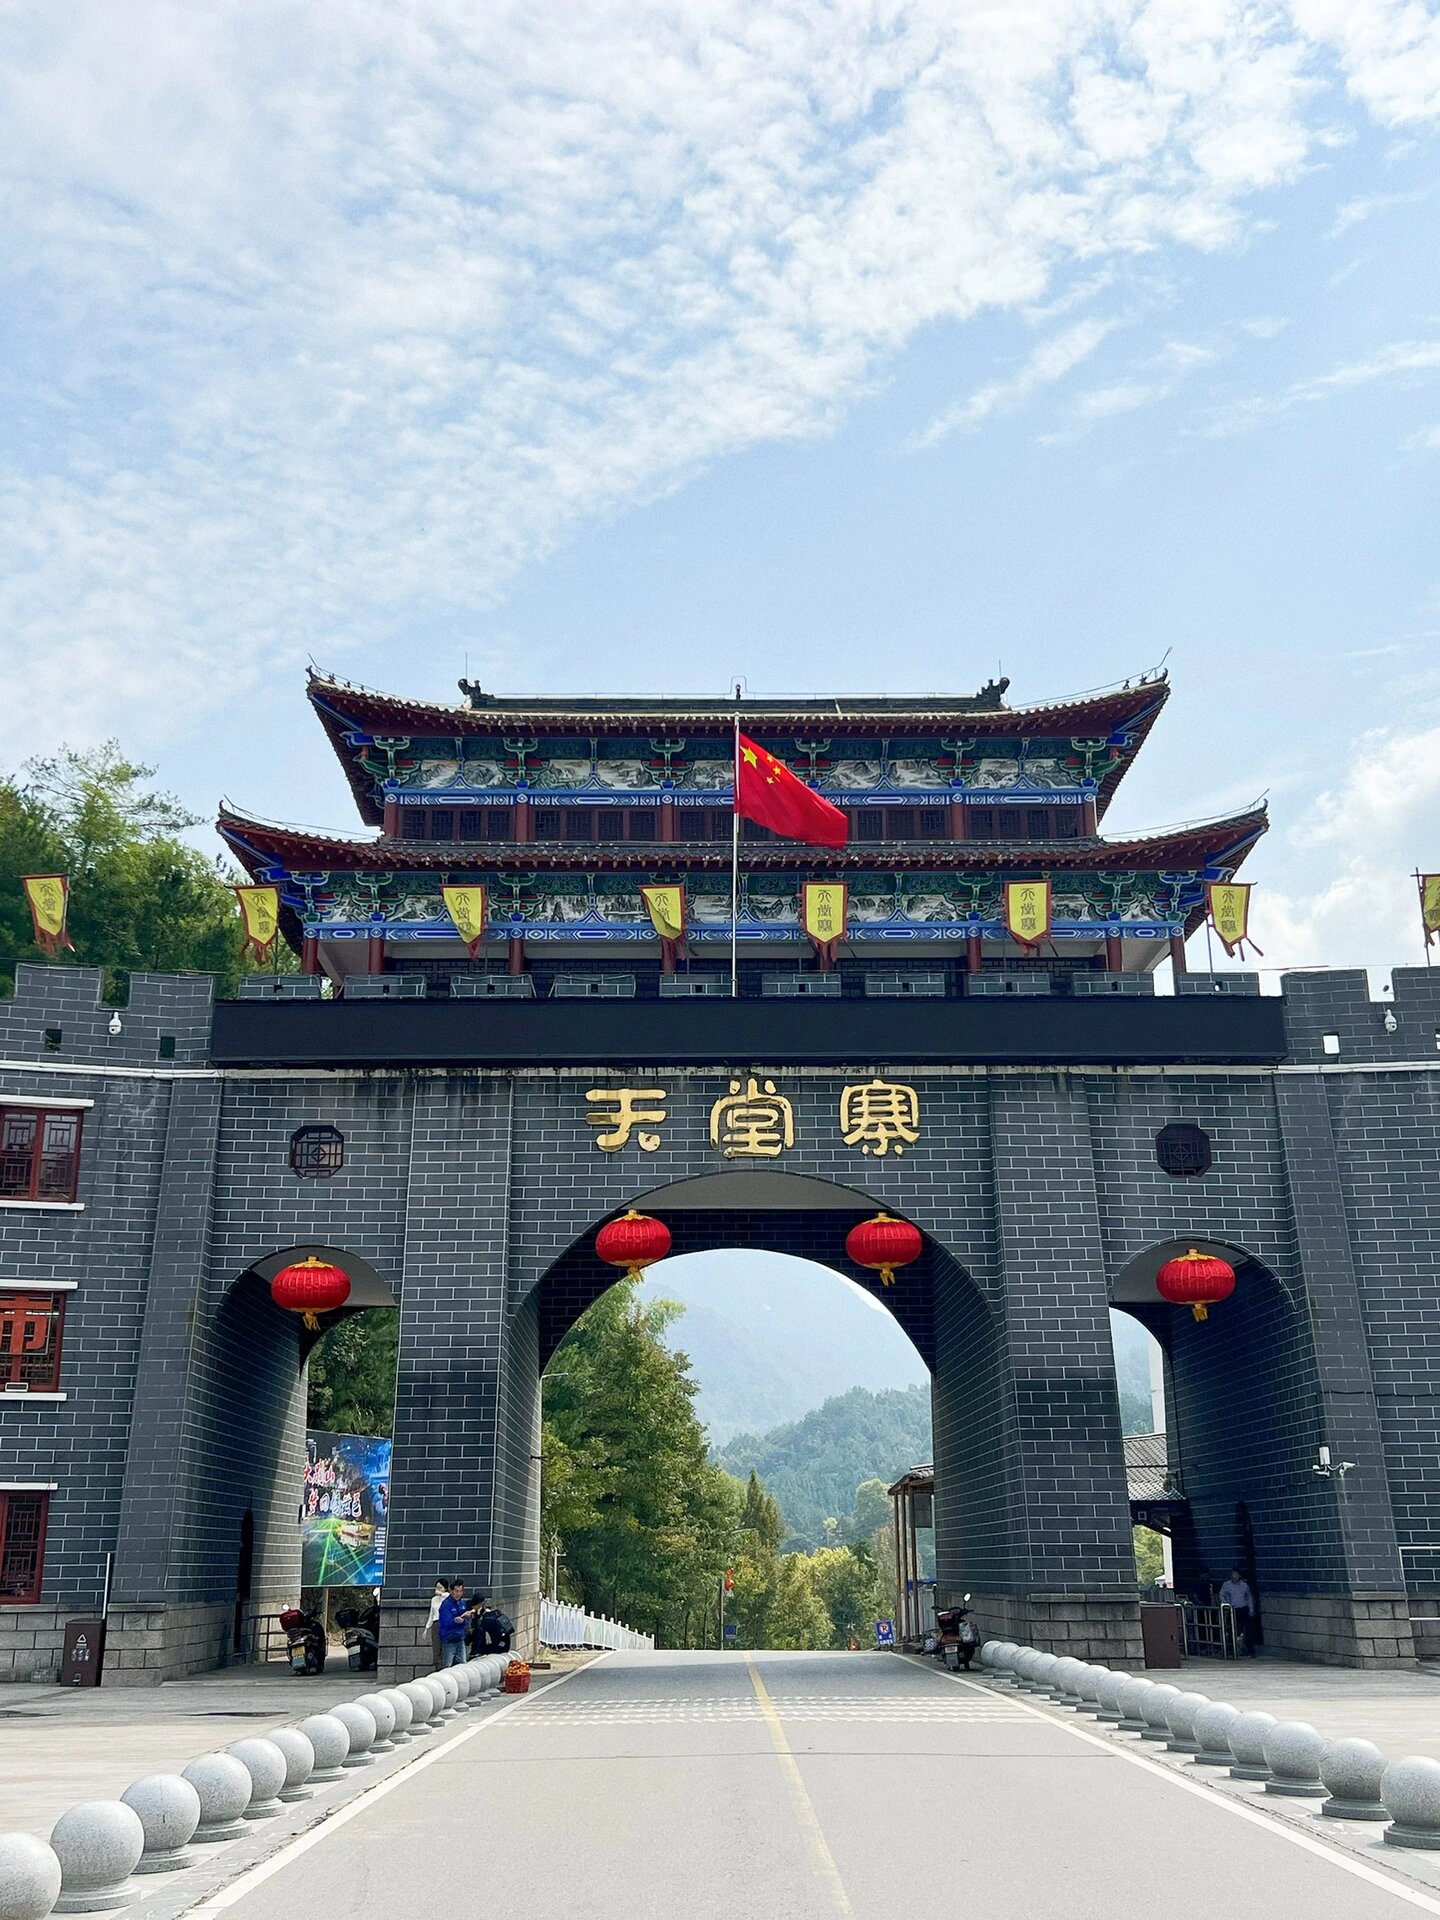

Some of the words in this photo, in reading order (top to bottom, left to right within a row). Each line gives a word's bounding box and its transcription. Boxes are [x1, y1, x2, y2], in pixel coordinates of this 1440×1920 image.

[817, 889, 833, 932] 天堂寨
[1020, 888, 1036, 931] 天堂寨
[1221, 890, 1236, 932] 天堂寨
[585, 1078, 921, 1158] 天堂寨
